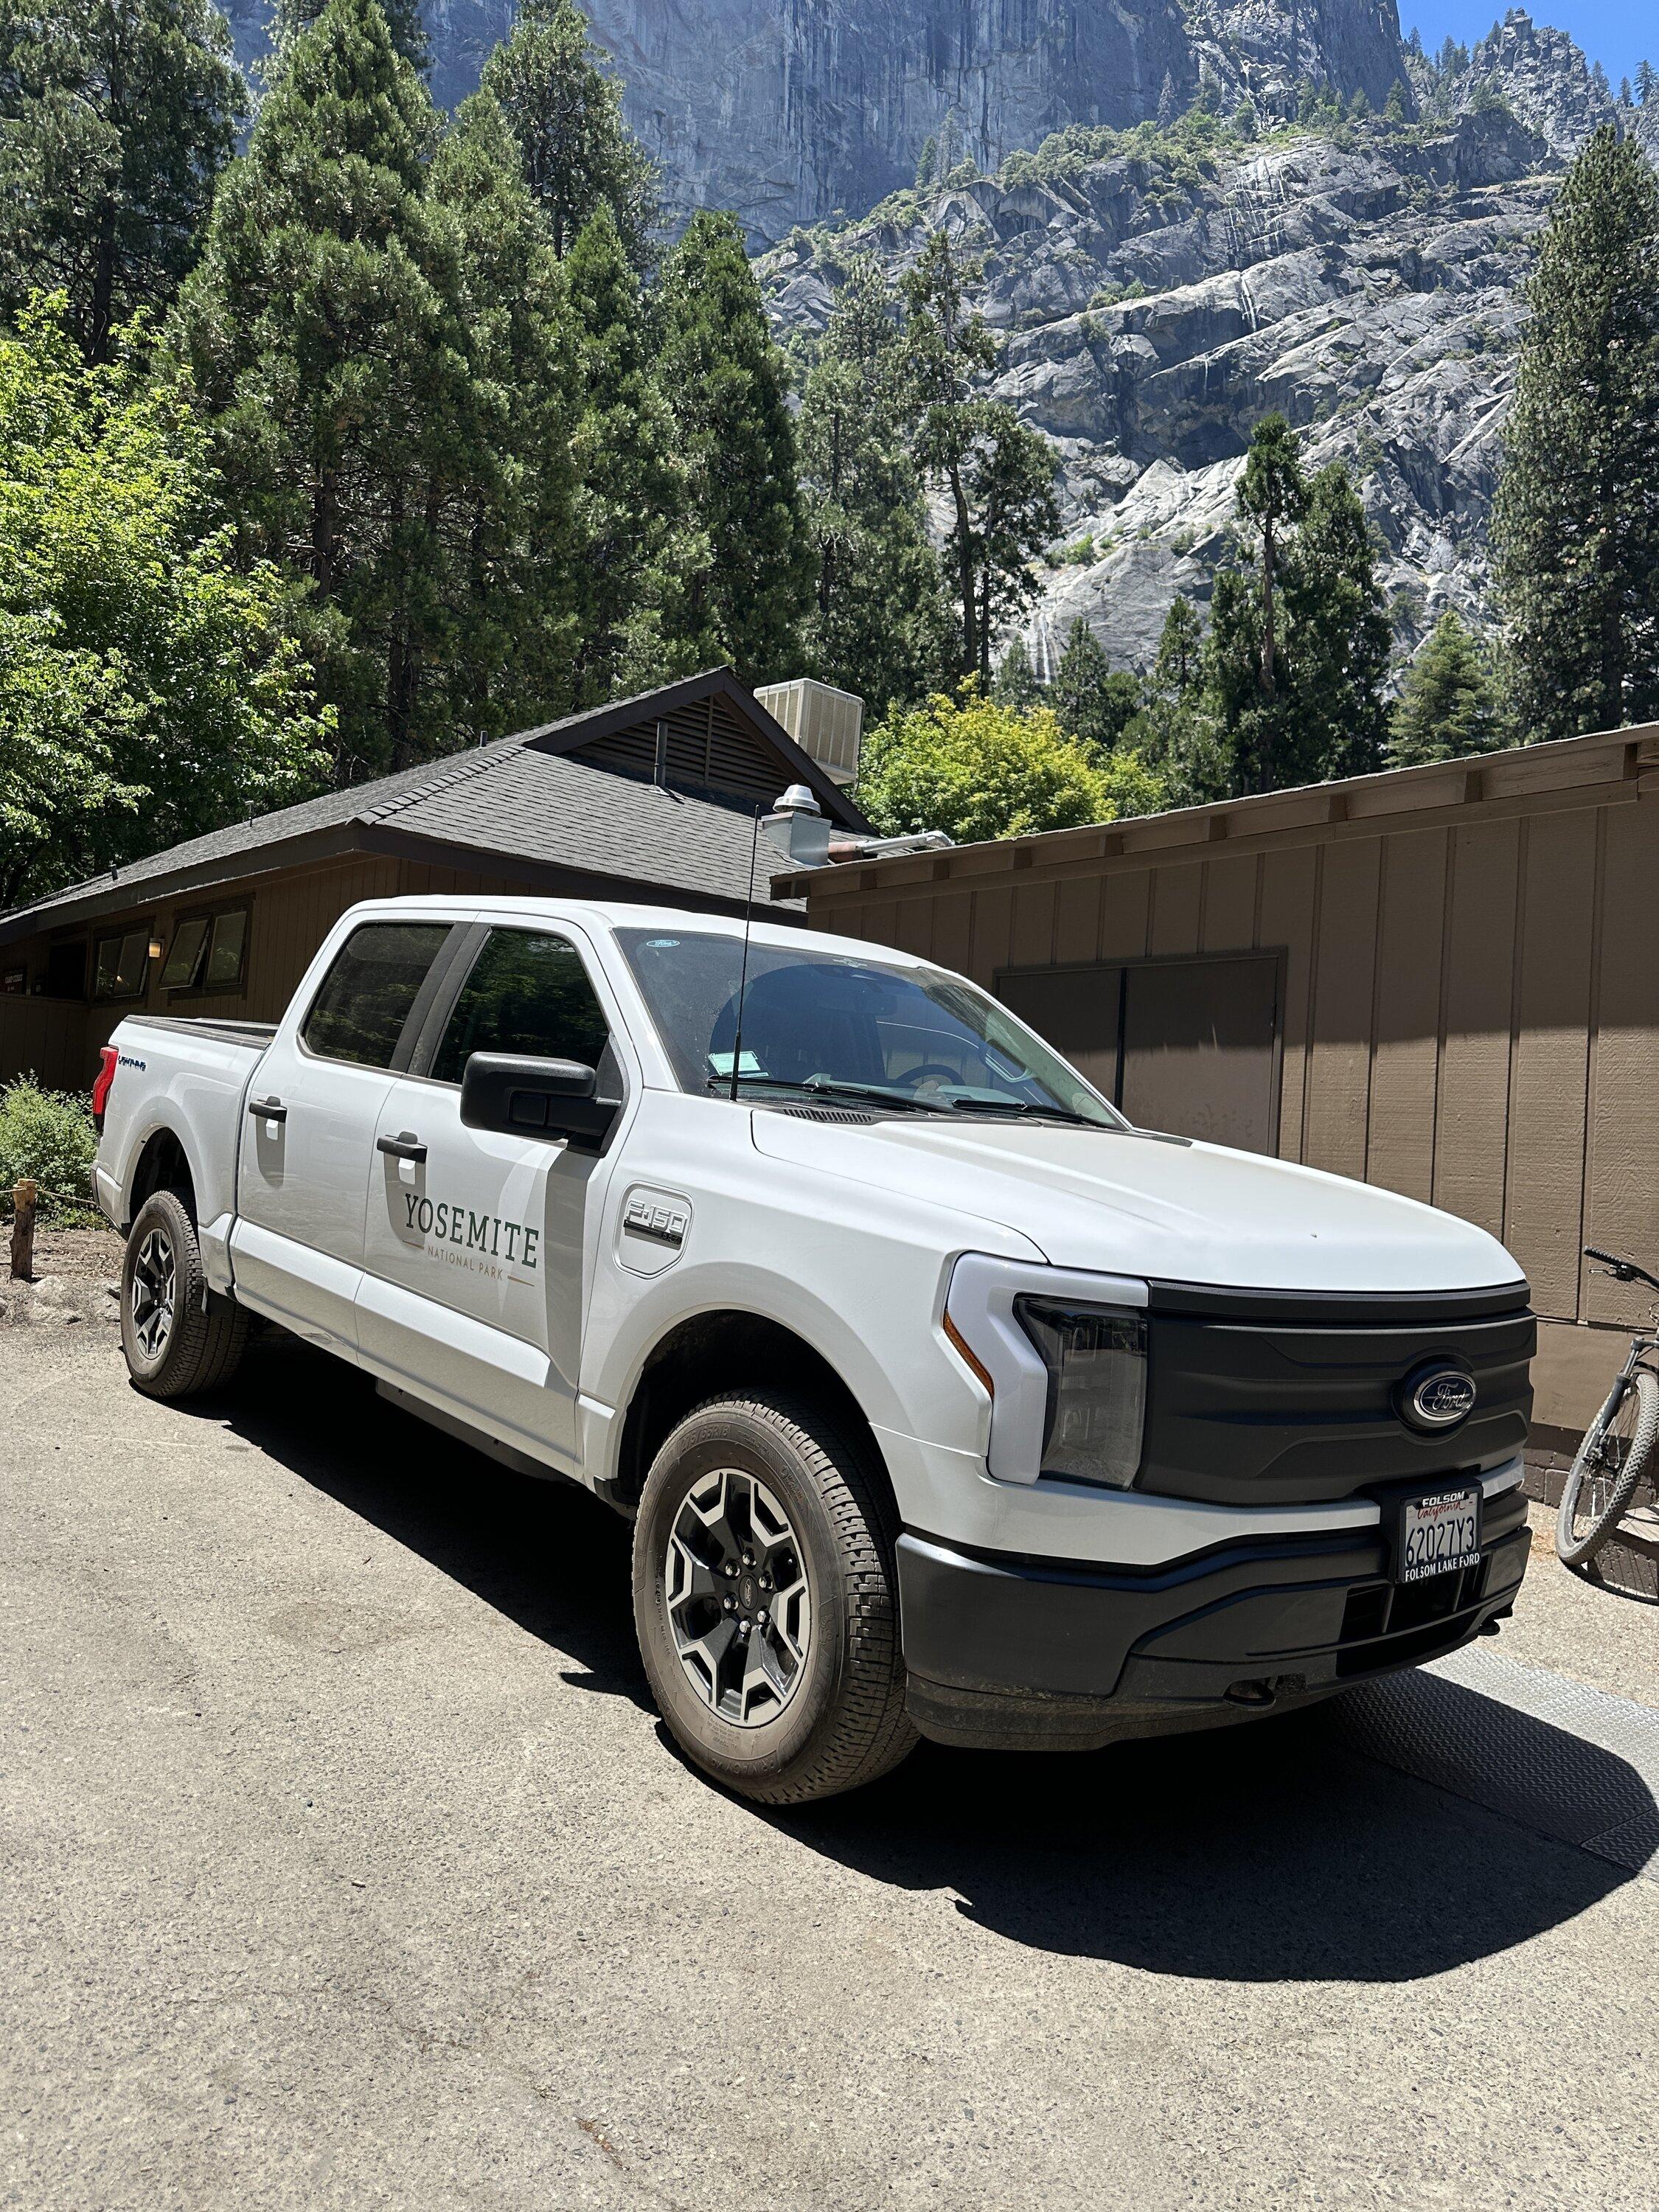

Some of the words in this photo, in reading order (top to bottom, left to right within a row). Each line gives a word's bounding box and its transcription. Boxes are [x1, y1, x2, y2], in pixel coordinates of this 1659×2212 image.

[405, 1193, 539, 1268] YOSEMITE
[626, 1199, 688, 1238] F-150
[428, 1245, 474, 1271] NATIONAL
[479, 1262, 503, 1281] PARK
[1430, 1382, 1469, 1411] Ford
[1417, 1502, 1466, 1522] California
[1422, 1491, 1465, 1507] FOLSOM
[1406, 1516, 1475, 1566] 62027Y3
[1405, 1563, 1436, 1582] FOLSOM
[1438, 1557, 1457, 1573] LAKE
[1459, 1552, 1480, 1568] FORD
